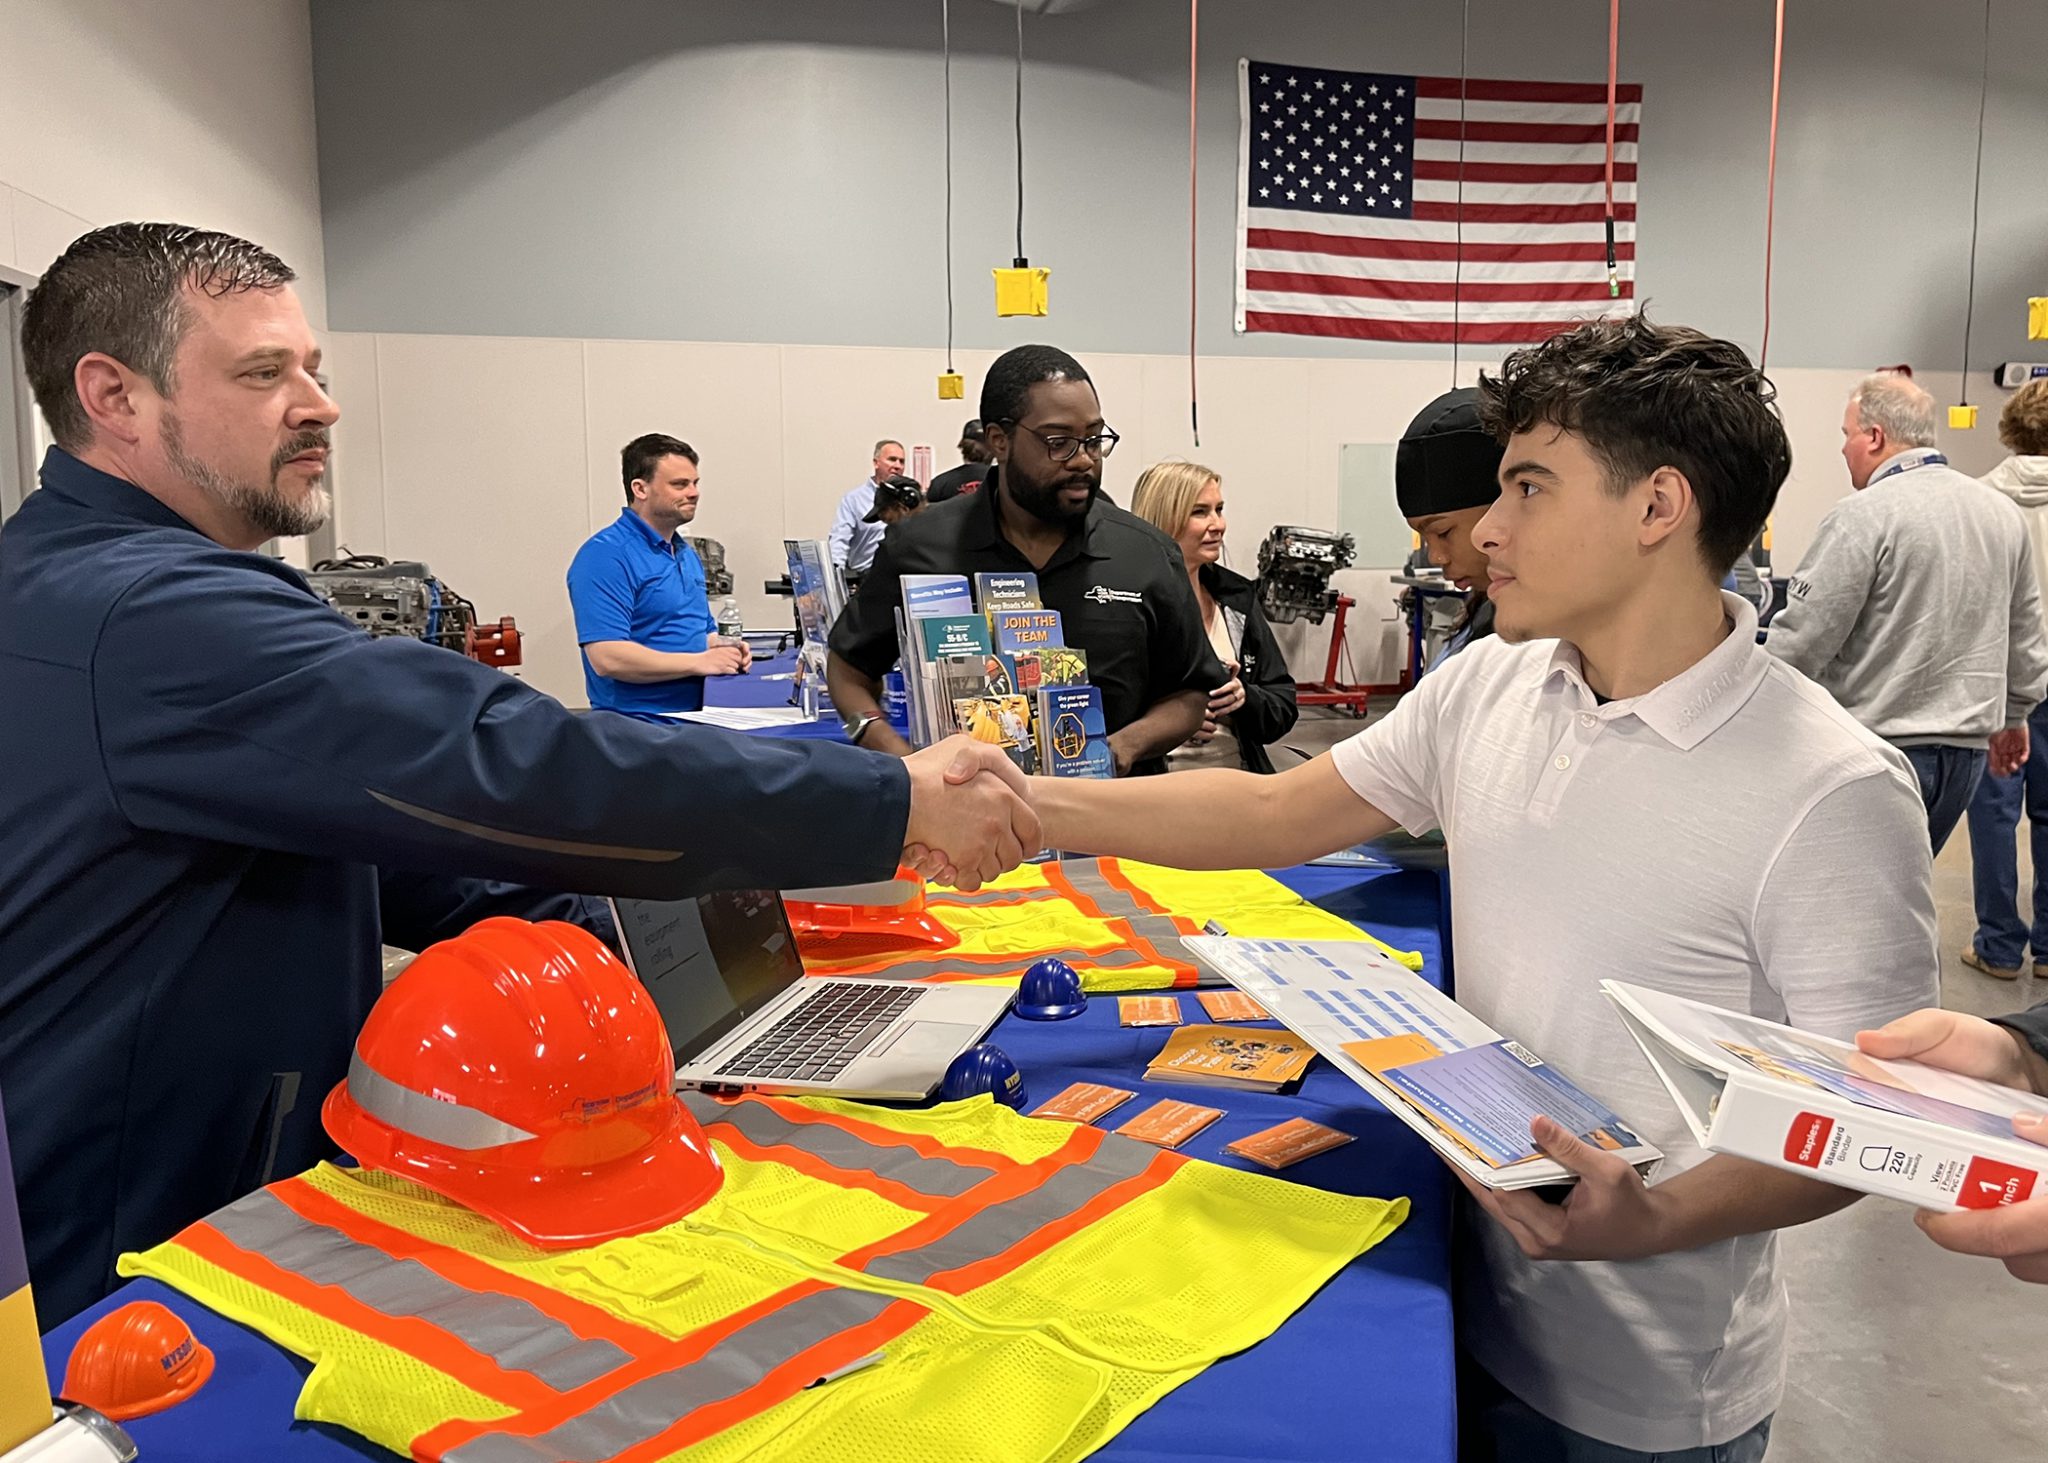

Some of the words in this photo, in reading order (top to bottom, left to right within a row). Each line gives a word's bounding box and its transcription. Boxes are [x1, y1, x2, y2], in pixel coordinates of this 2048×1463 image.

[990, 578, 1025, 588] Engineering
[992, 589, 1027, 599] Technicians
[986, 601, 1002, 611] Keep
[1001, 601, 1021, 610] Roads
[1022, 600, 1035, 610] Safe
[1003, 616, 1032, 630] JOIN
[1032, 615, 1056, 629] THE
[1013, 630, 1048, 644] TEAM
[1441, 1105, 1464, 1123] May
[1466, 1122, 1511, 1156] Benefits
[1798, 1121, 1820, 1162] Staples
[1824, 1126, 1845, 1166] Standard
[1836, 1135, 1852, 1162] Binder
[1889, 1151, 1906, 1174] 220
[1907, 1153, 1923, 1181] Capacity
[1930, 1162, 1944, 1183] View
[1950, 1179, 1960, 1193] PVC
[1955, 1163, 1966, 1178] Free
[1979, 1180, 2003, 1193] 1
[1998, 1177, 2020, 1206] Inch
